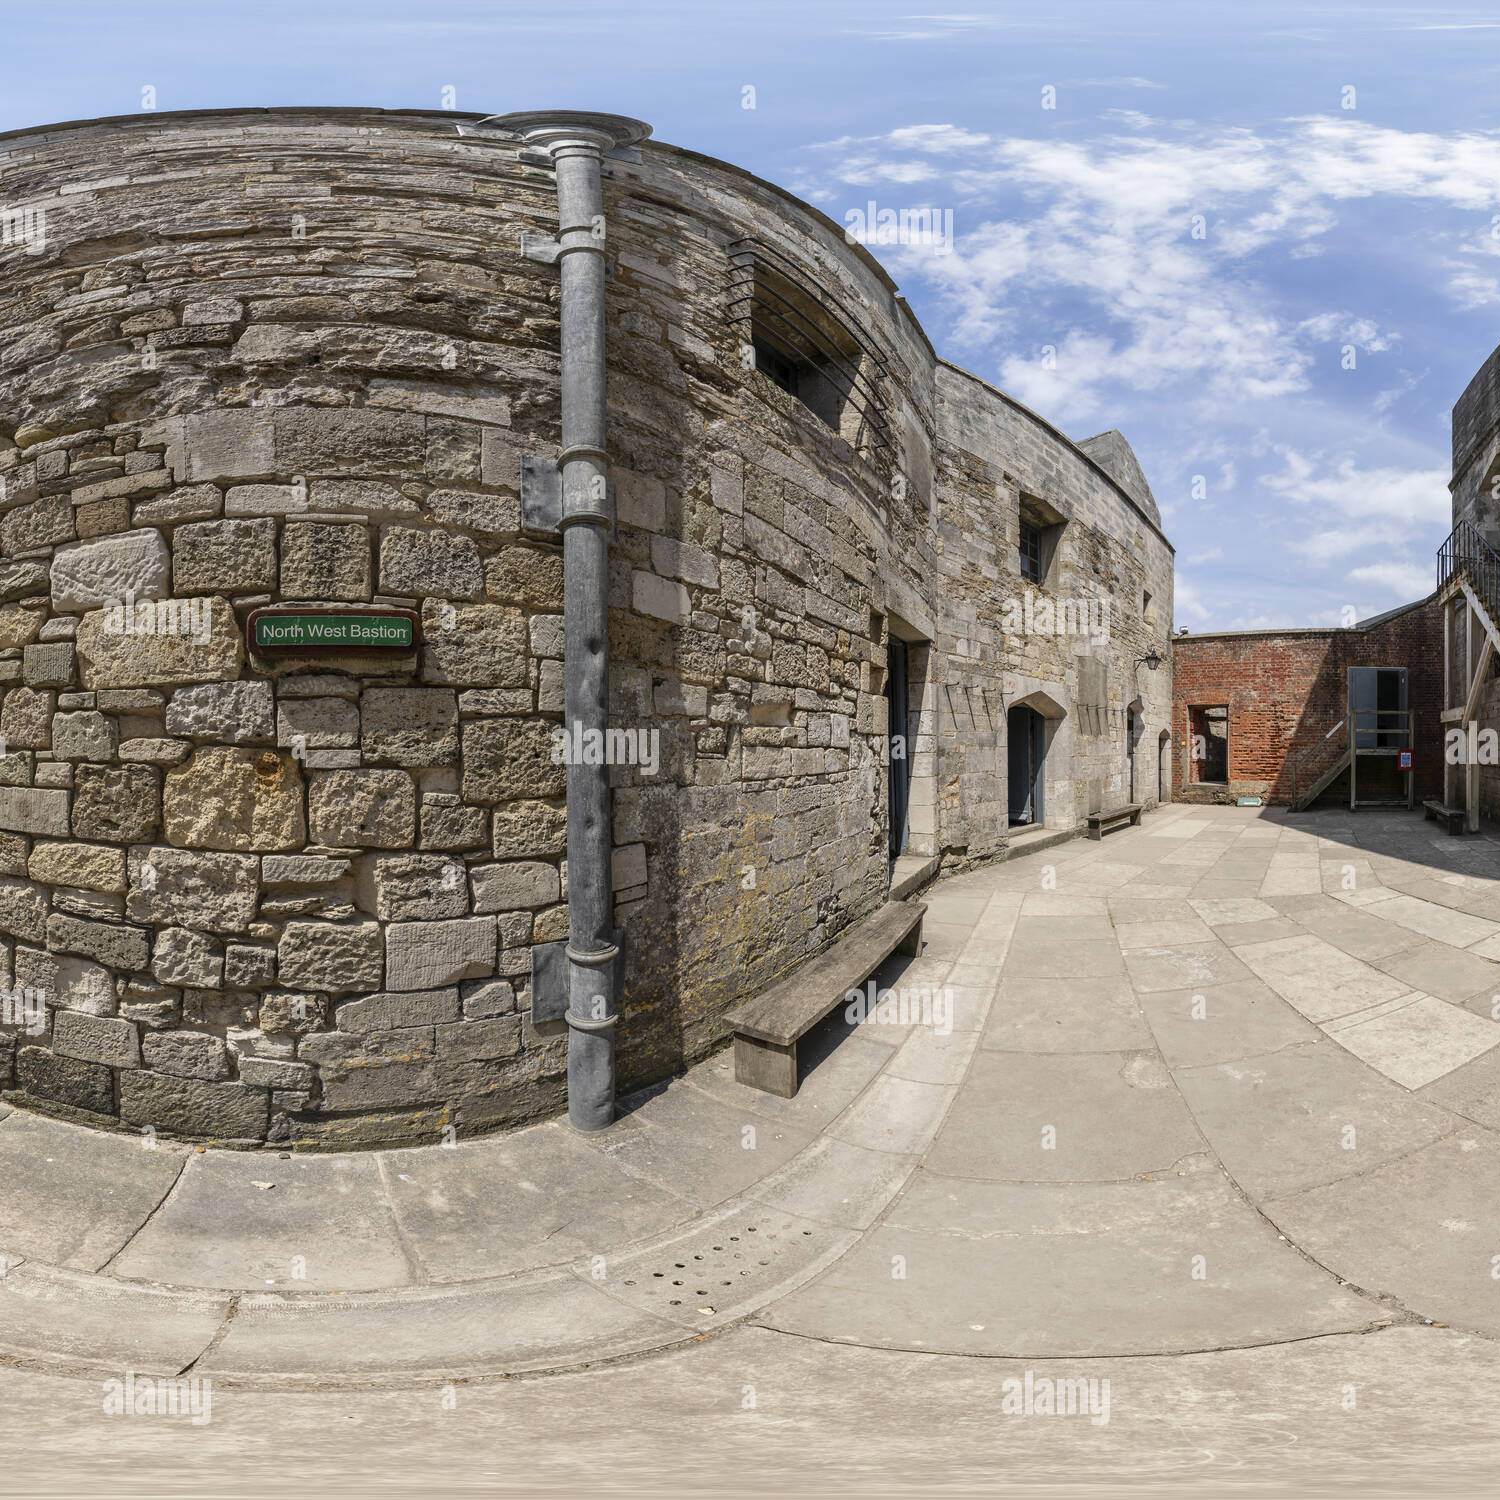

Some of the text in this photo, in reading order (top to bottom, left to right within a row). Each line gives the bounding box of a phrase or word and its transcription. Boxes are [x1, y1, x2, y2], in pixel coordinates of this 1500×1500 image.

[263, 624, 407, 639] North West Bastion
